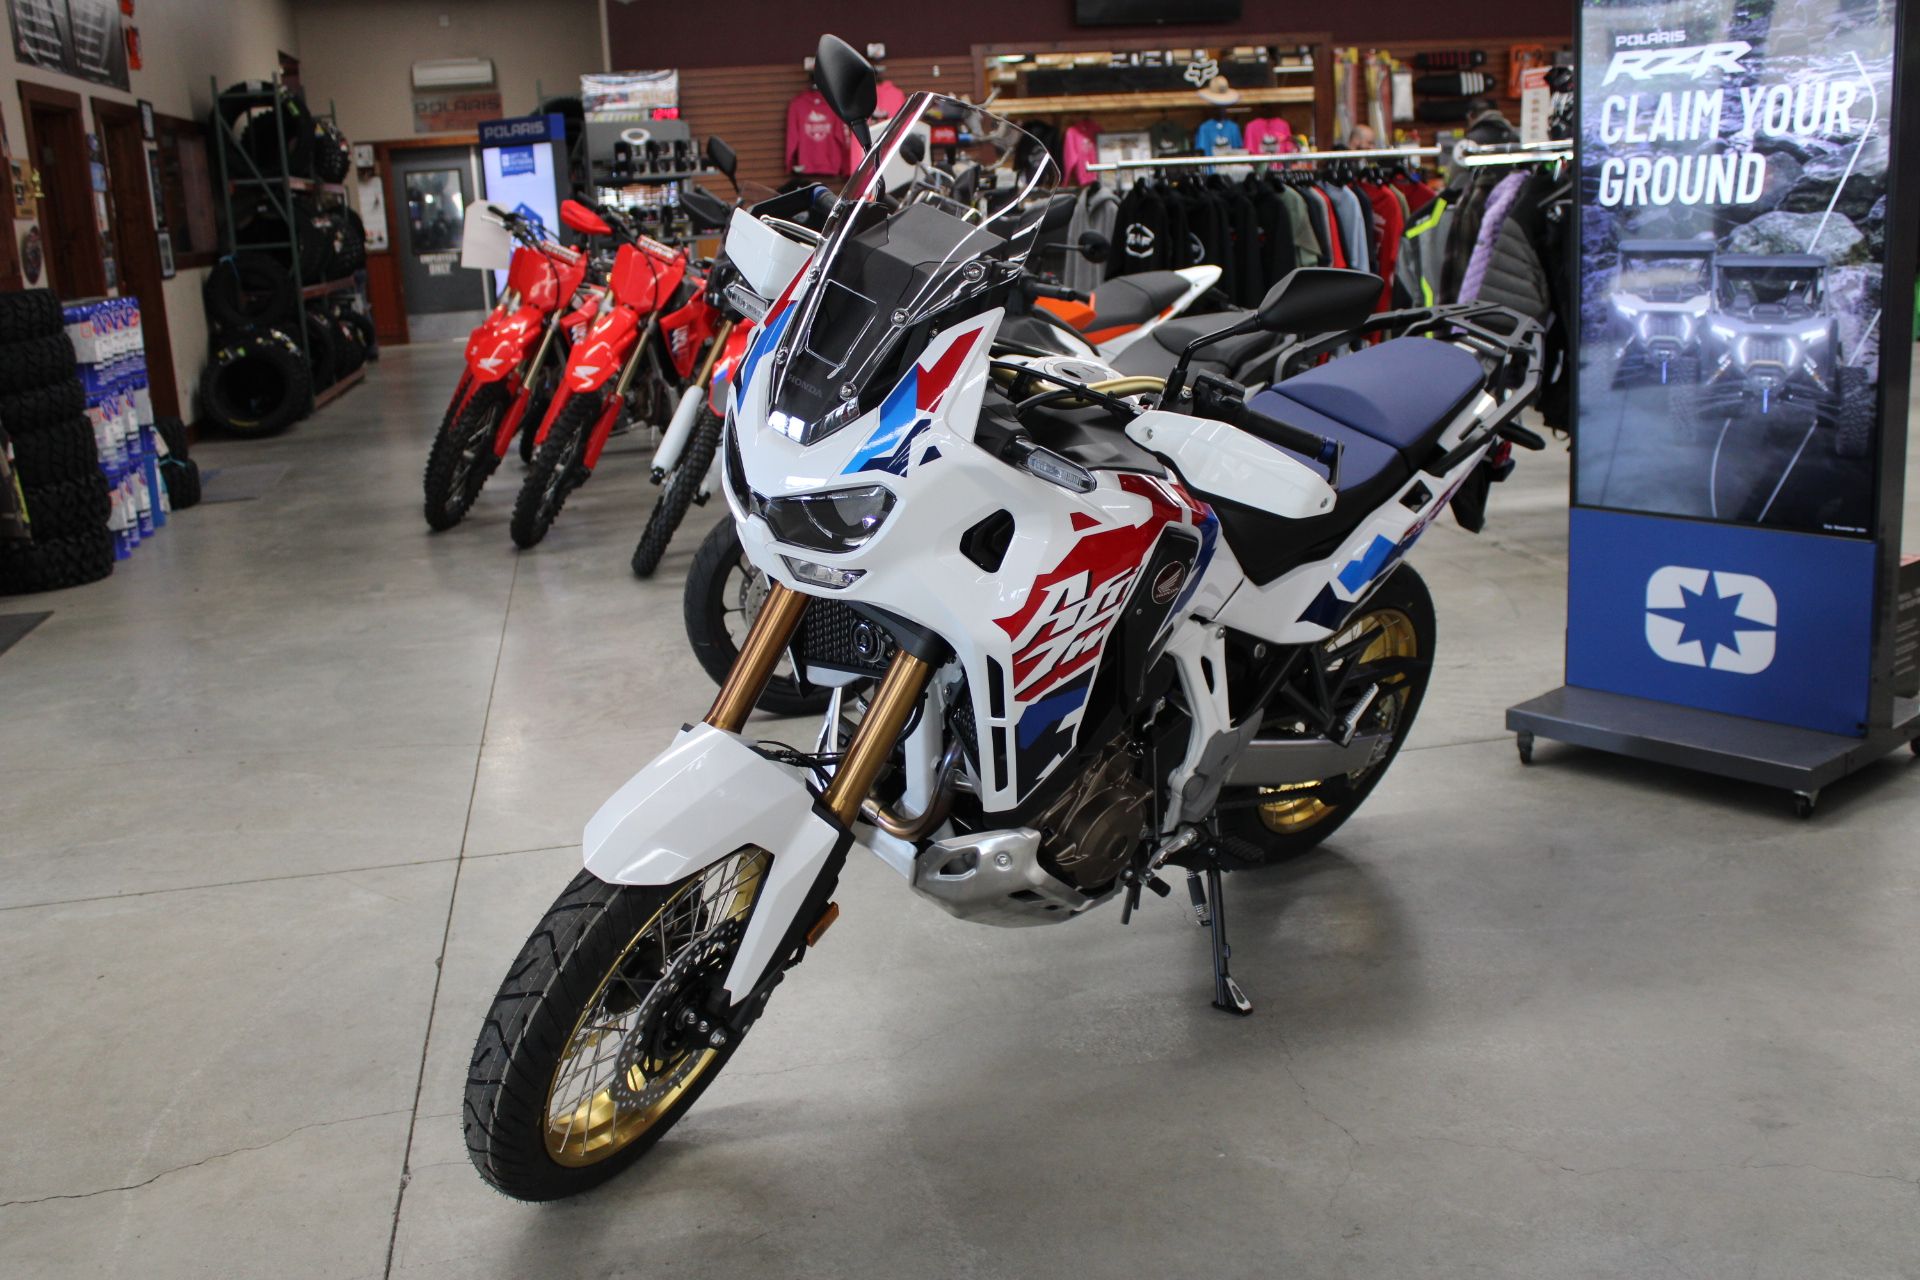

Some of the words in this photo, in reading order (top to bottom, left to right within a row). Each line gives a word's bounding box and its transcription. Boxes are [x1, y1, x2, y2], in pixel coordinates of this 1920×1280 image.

[1615, 30, 1686, 47] POLARIS
[1601, 40, 1752, 87] RZR
[415, 99, 500, 114] POLARIS
[1600, 87, 1725, 145] CLAIM
[1739, 80, 1857, 138] YOUR
[484, 121, 545, 139] POLARIS
[1599, 152, 1767, 207] GROUND
[788, 373, 823, 398] HONDA
